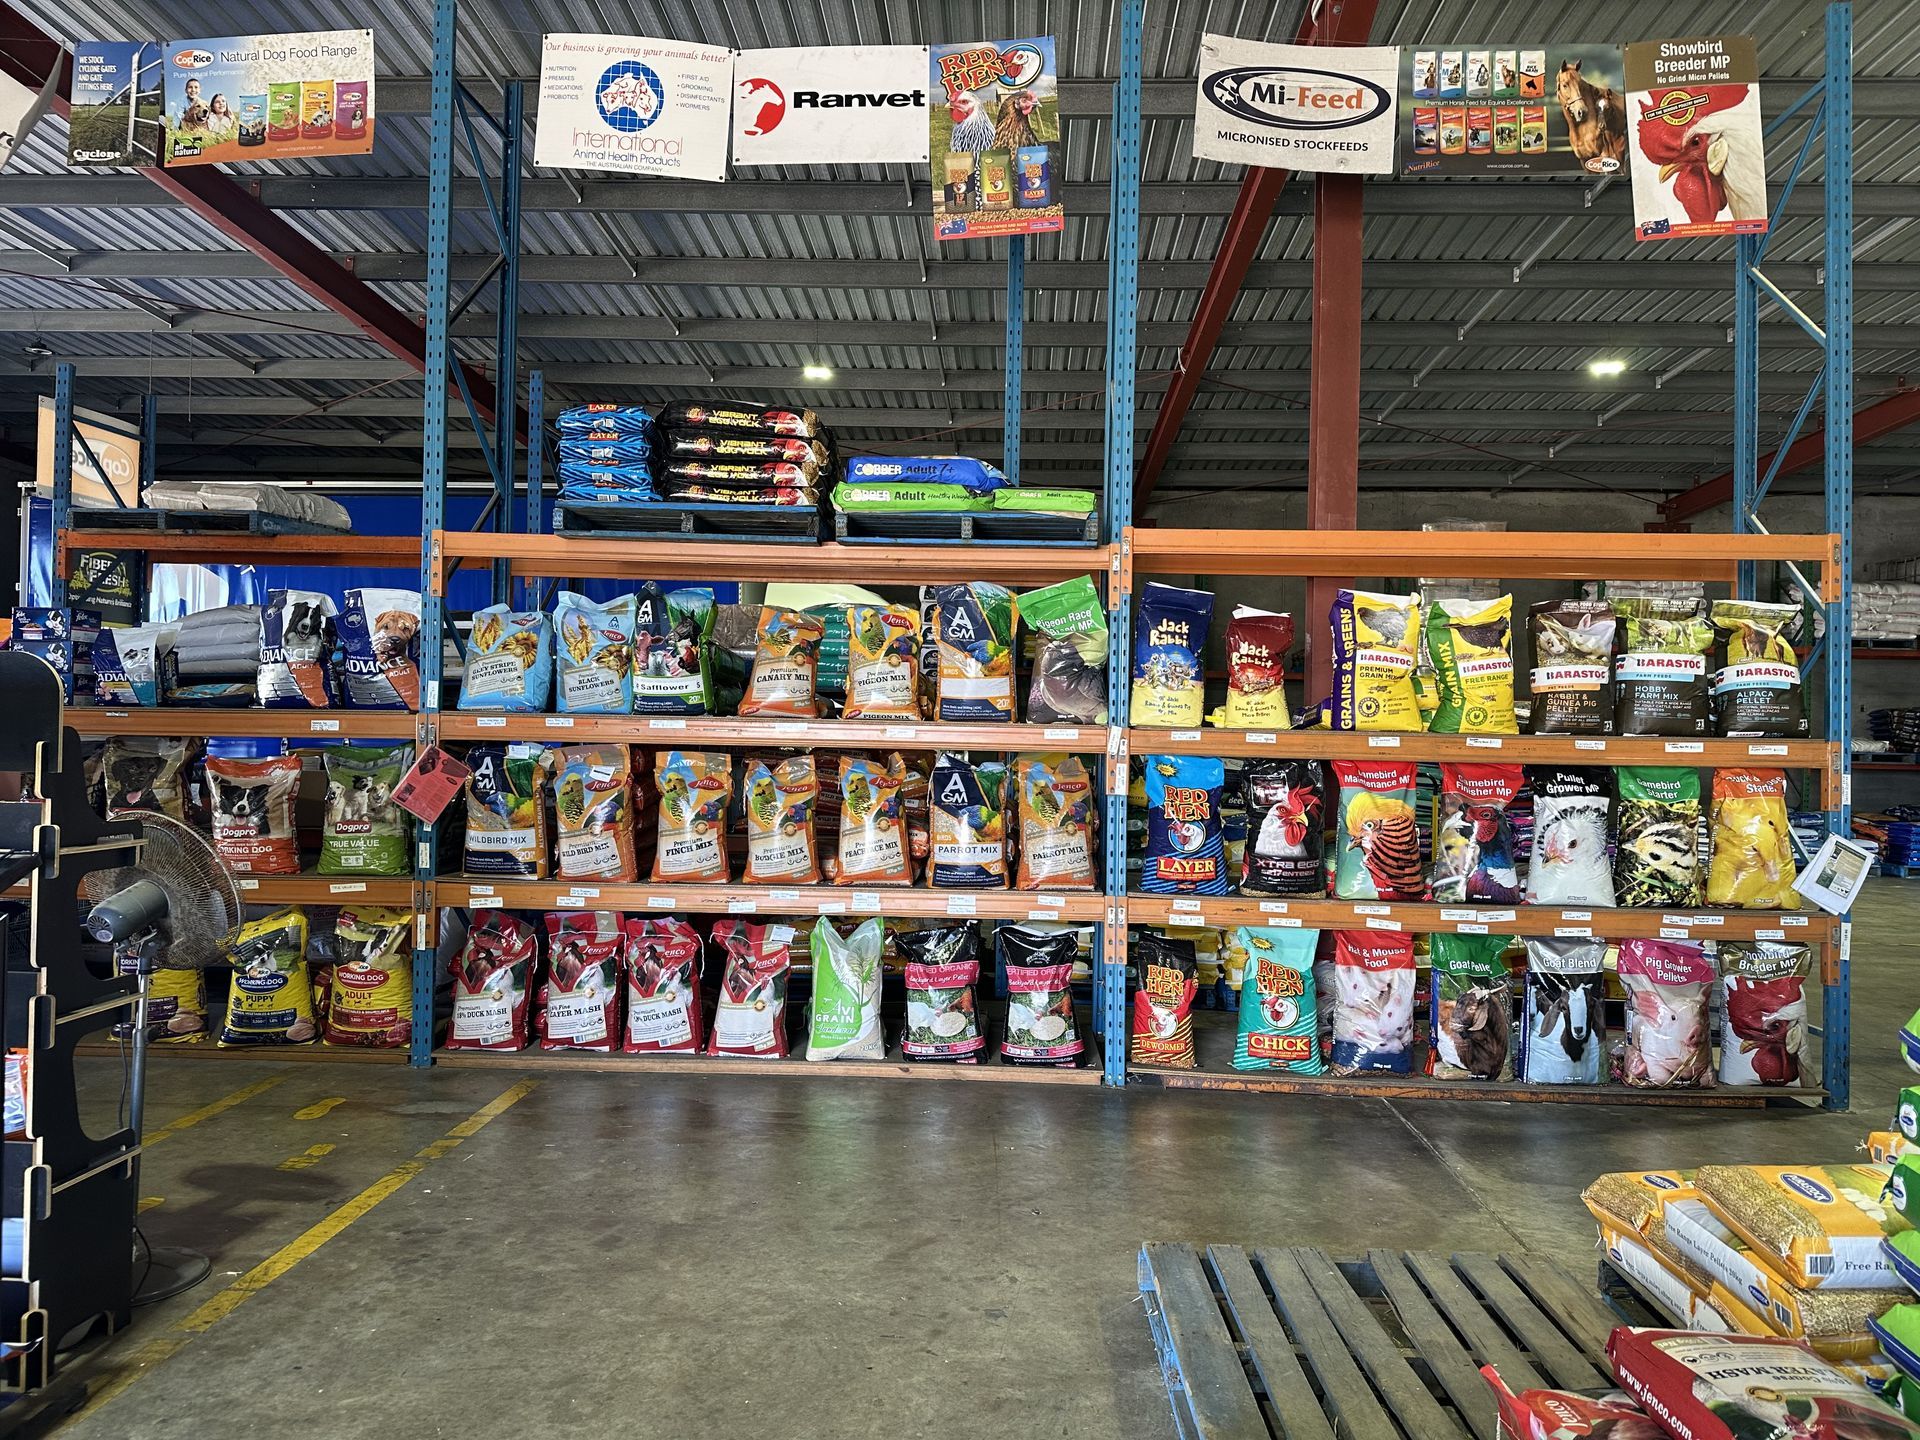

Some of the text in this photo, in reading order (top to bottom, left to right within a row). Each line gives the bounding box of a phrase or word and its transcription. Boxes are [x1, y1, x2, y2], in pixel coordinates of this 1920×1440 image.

[221, 46, 357, 62] Natural Dog Food Range
[563, 42, 595, 52] business
[597, 44, 604, 53] is
[606, 45, 640, 60] growing
[643, 48, 662, 60] your
[665, 49, 698, 60] animals
[1660, 40, 1722, 58] Showbird
[175, 53, 212, 66] CopRice
[939, 47, 998, 77] RED
[1654, 56, 1731, 74] Breeder MP
[1657, 72, 1730, 84] No Grind Micro Pellets
[681, 83, 713, 92] GROOMING
[680, 93, 725, 104] DISINFECTANTS
[793, 90, 925, 108] Ranvet
[1251, 82, 1363, 109] Mi-Feed
[679, 102, 710, 111] WORMERS
[572, 127, 683, 156] International
[1217, 130, 1368, 152] MICRONISED STOCKFEEDS
[73, 150, 121, 161] Cyclone
[573, 149, 681, 168] Animal Health Products
[1407, 160, 1440, 172] NutriRice
[1588, 160, 1617, 169] CopRice
[712, 410, 758, 421] VIBRANT
[854, 462, 955, 475] COBBER Adult 7+
[895, 491, 926, 500] Adult
[887, 616, 911, 629] Jenco
[1036, 610, 1092, 630] Pigeon Race
[1078, 620, 1092, 631] MP
[1157, 618, 1189, 633] Jack
[1360, 654, 1411, 666] BARASTOC
[1637, 659, 1700, 669] BARASTOC
[389, 668, 410, 678] ADULT
[471, 666, 518, 680] SUNFLOWERS
[1340, 608, 1355, 730] GRAINS & GREENS
[1438, 641, 1462, 708] GRAIN MIX
[1546, 670, 1606, 680] BARASTOC
[1736, 669, 1796, 679] BARASTOC
[98, 672, 148, 682] ADVANCE
[757, 673, 810, 683] CANARY MIX
[858, 675, 907, 686] PIGEON MIX
[1465, 674, 1508, 684] FREE RANGE
[568, 679, 614, 693] SUNFLOWERS
[641, 683, 689, 691] Safflower
[1556, 772, 1584, 785] Pullet
[592, 780, 617, 790] Jenco
[1456, 781, 1512, 796] Finisher MP
[1547, 784, 1600, 794] Grower MP
[1165, 785, 1208, 804] RED
[1164, 802, 1210, 821] HEN
[222, 828, 256, 837] Dogpro
[336, 823, 369, 832] Dogpro
[350, 839, 379, 848] VALUE
[469, 836, 507, 844] WILDBIRD
[885, 841, 898, 850] MIX
[252, 845, 272, 853] DOG
[577, 847, 593, 856] BIRD
[666, 840, 713, 856] FINCH MIX
[788, 847, 804, 856] MIX
[1160, 859, 1215, 872] LAYER
[1363, 947, 1370, 957] &
[754, 958, 777, 968] Jenco
[938, 963, 973, 973] ORGANIC
[1258, 957, 1300, 978] RED
[1365, 958, 1388, 967] Food
[1450, 960, 1470, 969] Goat
[1543, 957, 1596, 968] Goat Blend
[1645, 957, 1692, 973] Pig Grower
[1780, 958, 1797, 969] MP
[1148, 965, 1184, 982] RED
[1657, 970, 1687, 982] Pellets
[1146, 979, 1184, 996] HEN
[1256, 975, 1304, 996] HEN
[574, 1005, 601, 1014] MASH
[644, 1008, 682, 1021] DUCK MASH
[816, 1014, 854, 1023] GRAIN
[1142, 1040, 1184, 1051] DEWORMER
[1251, 1036, 1309, 1051] CHICK
[1676, 1227, 1692, 1244] Range
[1693, 1240, 1710, 1256] Layer
[1710, 1250, 1728, 1270] Pellets
[1844, 1261, 1871, 1271] Free
[1706, 1366, 1842, 1380] LAYER MASH
[1545, 1400, 1588, 1429] Jenco
